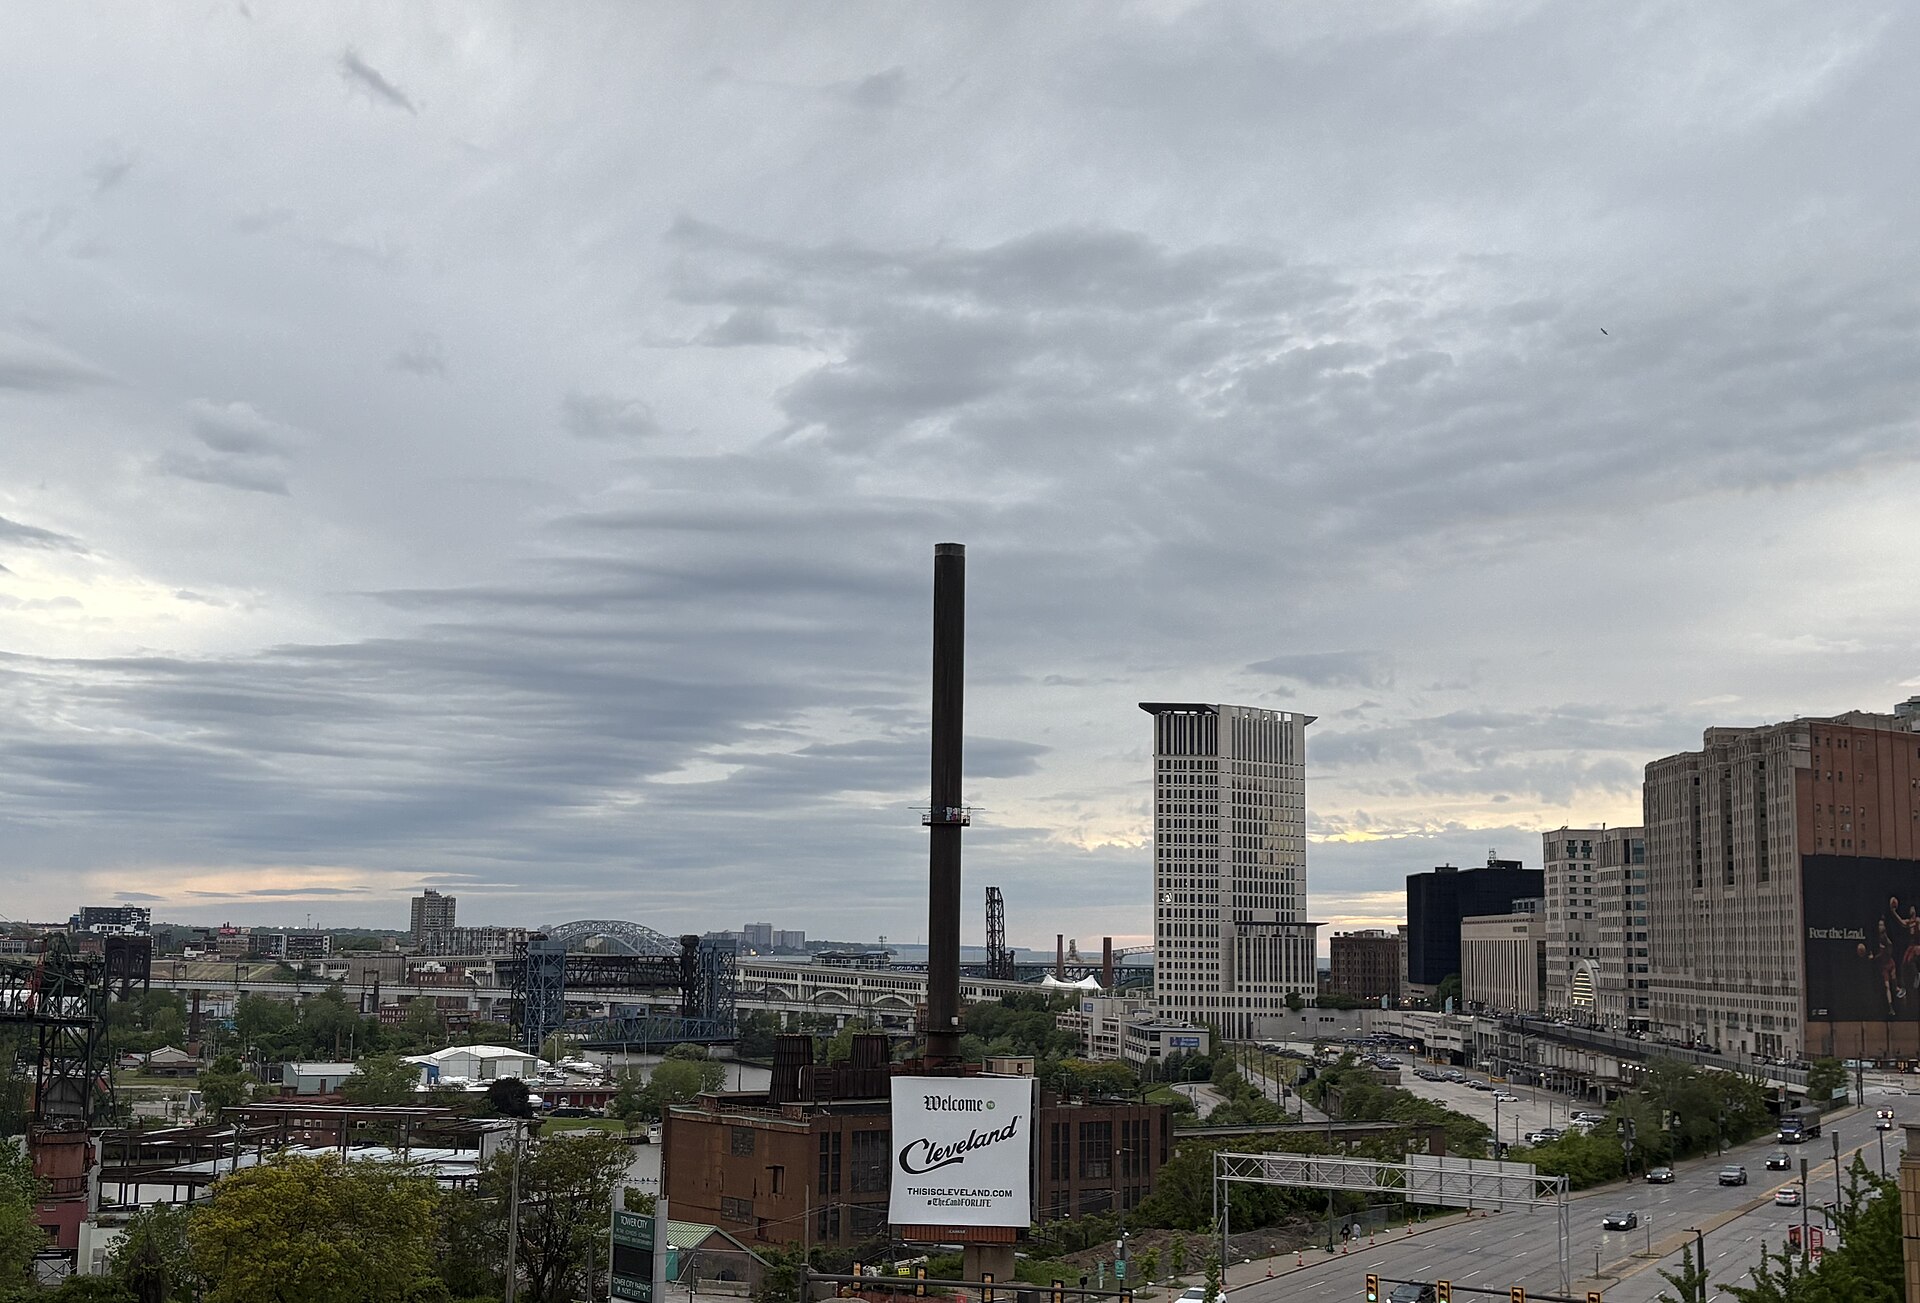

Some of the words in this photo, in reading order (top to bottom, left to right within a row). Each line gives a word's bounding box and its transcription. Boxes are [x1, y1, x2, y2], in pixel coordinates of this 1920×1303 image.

[1829, 927, 1843, 939] the
[923, 1095, 983, 1112] Welcome
[898, 1115, 1019, 1175] Cleveland
[907, 1187, 1013, 1198] THISISCLEVELAND.COM
